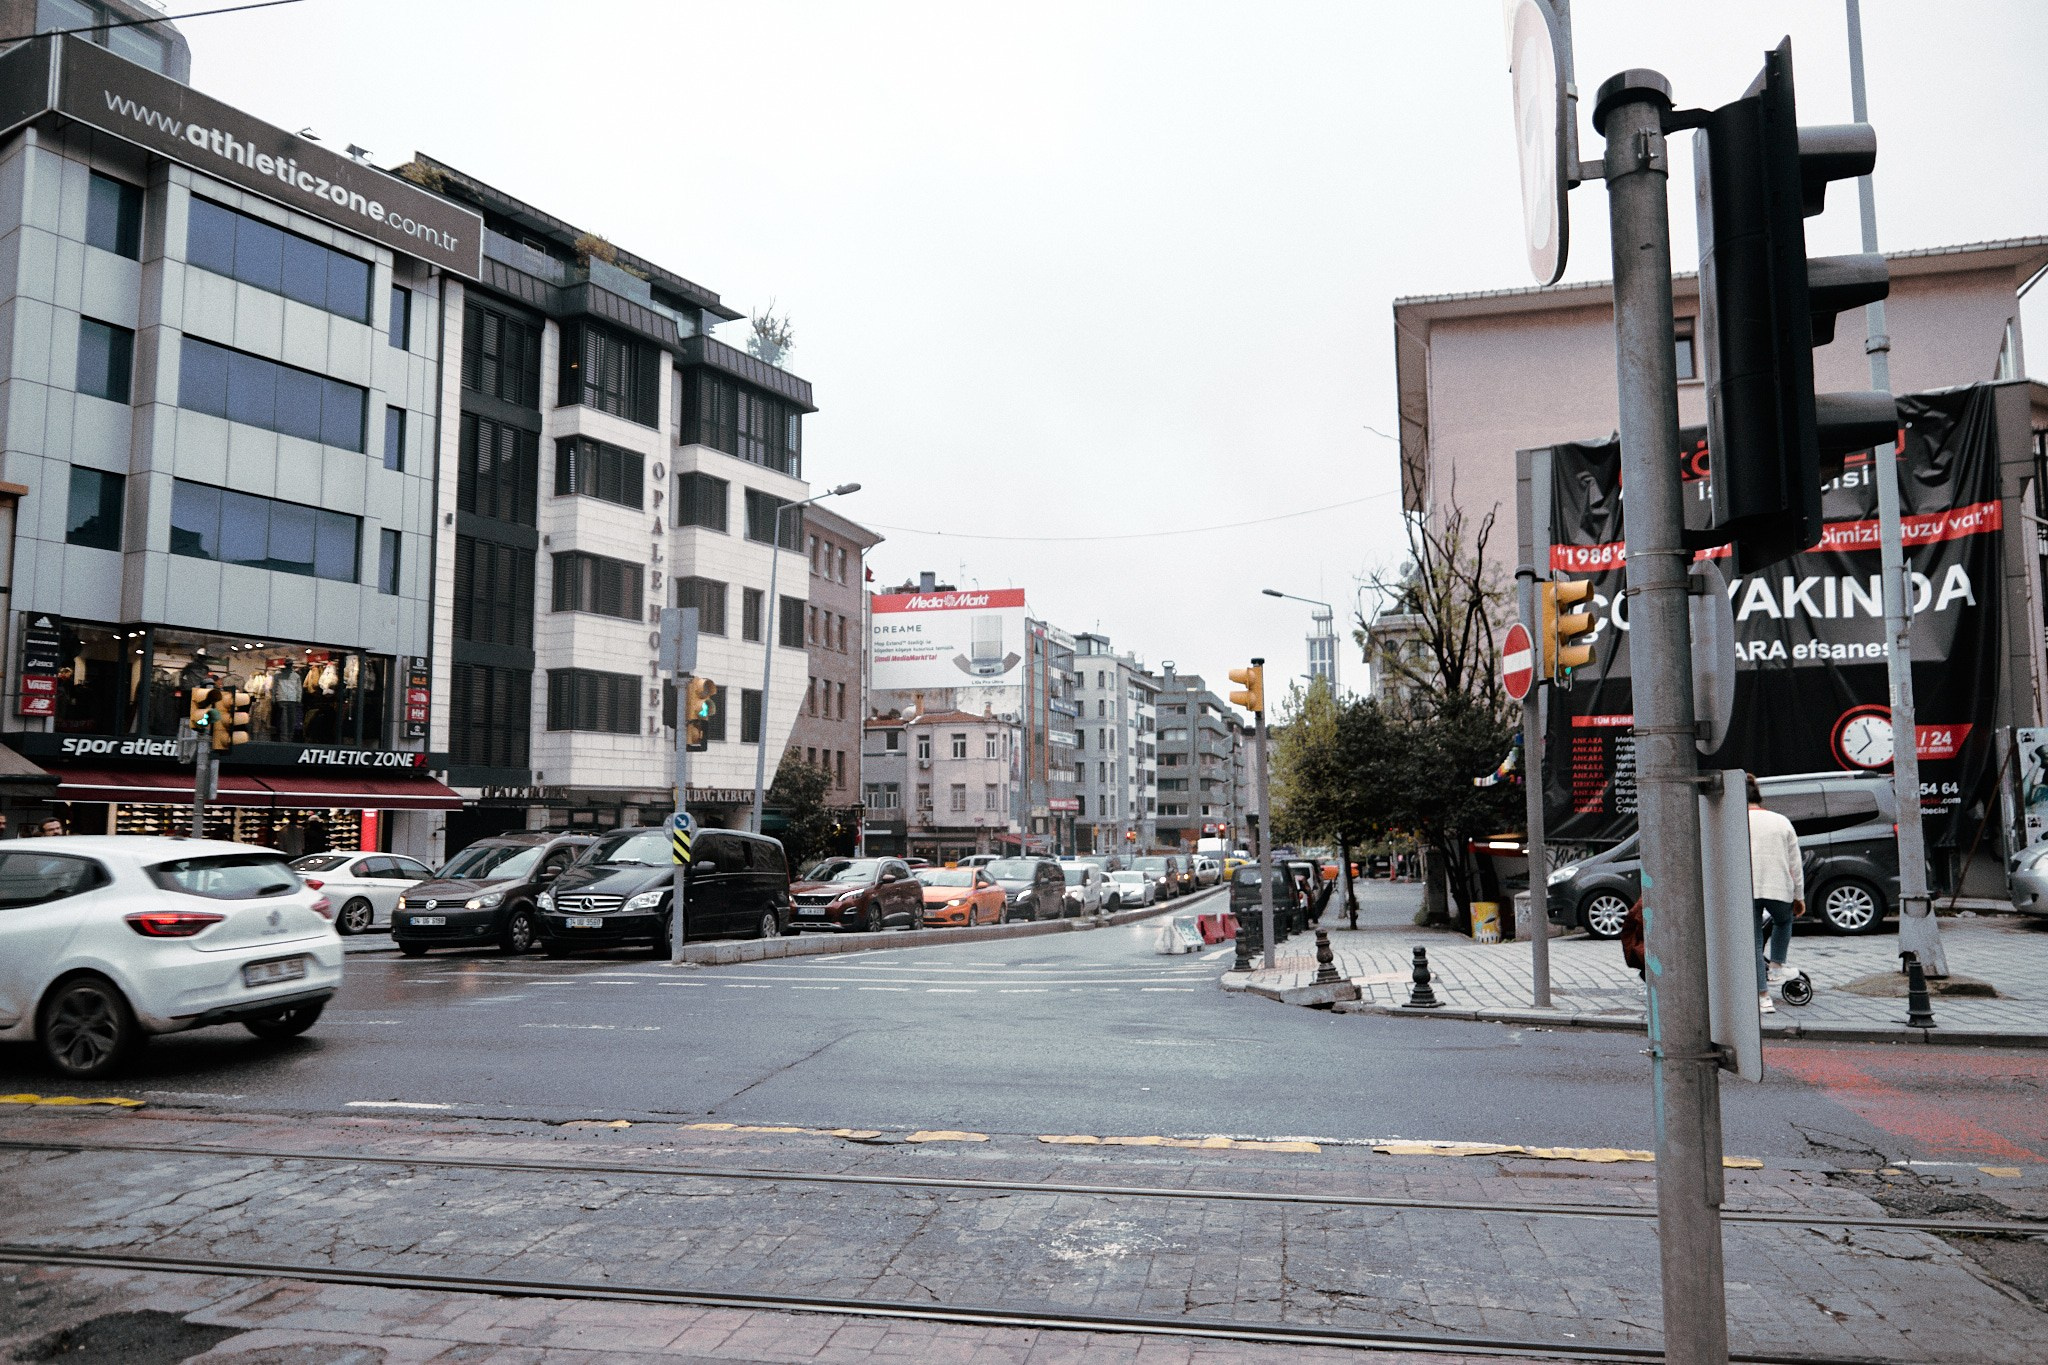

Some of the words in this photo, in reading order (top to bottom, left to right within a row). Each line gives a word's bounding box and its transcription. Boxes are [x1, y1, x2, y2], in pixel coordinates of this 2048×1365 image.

[104, 89, 459, 252] www.athleticzone.com.tr
[651, 461, 665, 591] OPALE
[905, 597, 943, 610] Media
[953, 594, 990, 607] Markt
[874, 625, 921, 634] DREAME
[1735, 638, 1788, 662] ARA
[1791, 638, 1889, 661] efsanes
[27, 679, 53, 691] VANS
[1593, 716, 1609, 724] TÜM
[1931, 731, 1952, 746] 24
[62, 738, 119, 756] spor
[120, 738, 180, 757] atleti
[298, 748, 372, 766] ATHLETIC
[373, 751, 414, 767] ZONE
[1920, 783, 1938, 795] 54
[1941, 782, 1959, 794] 64
